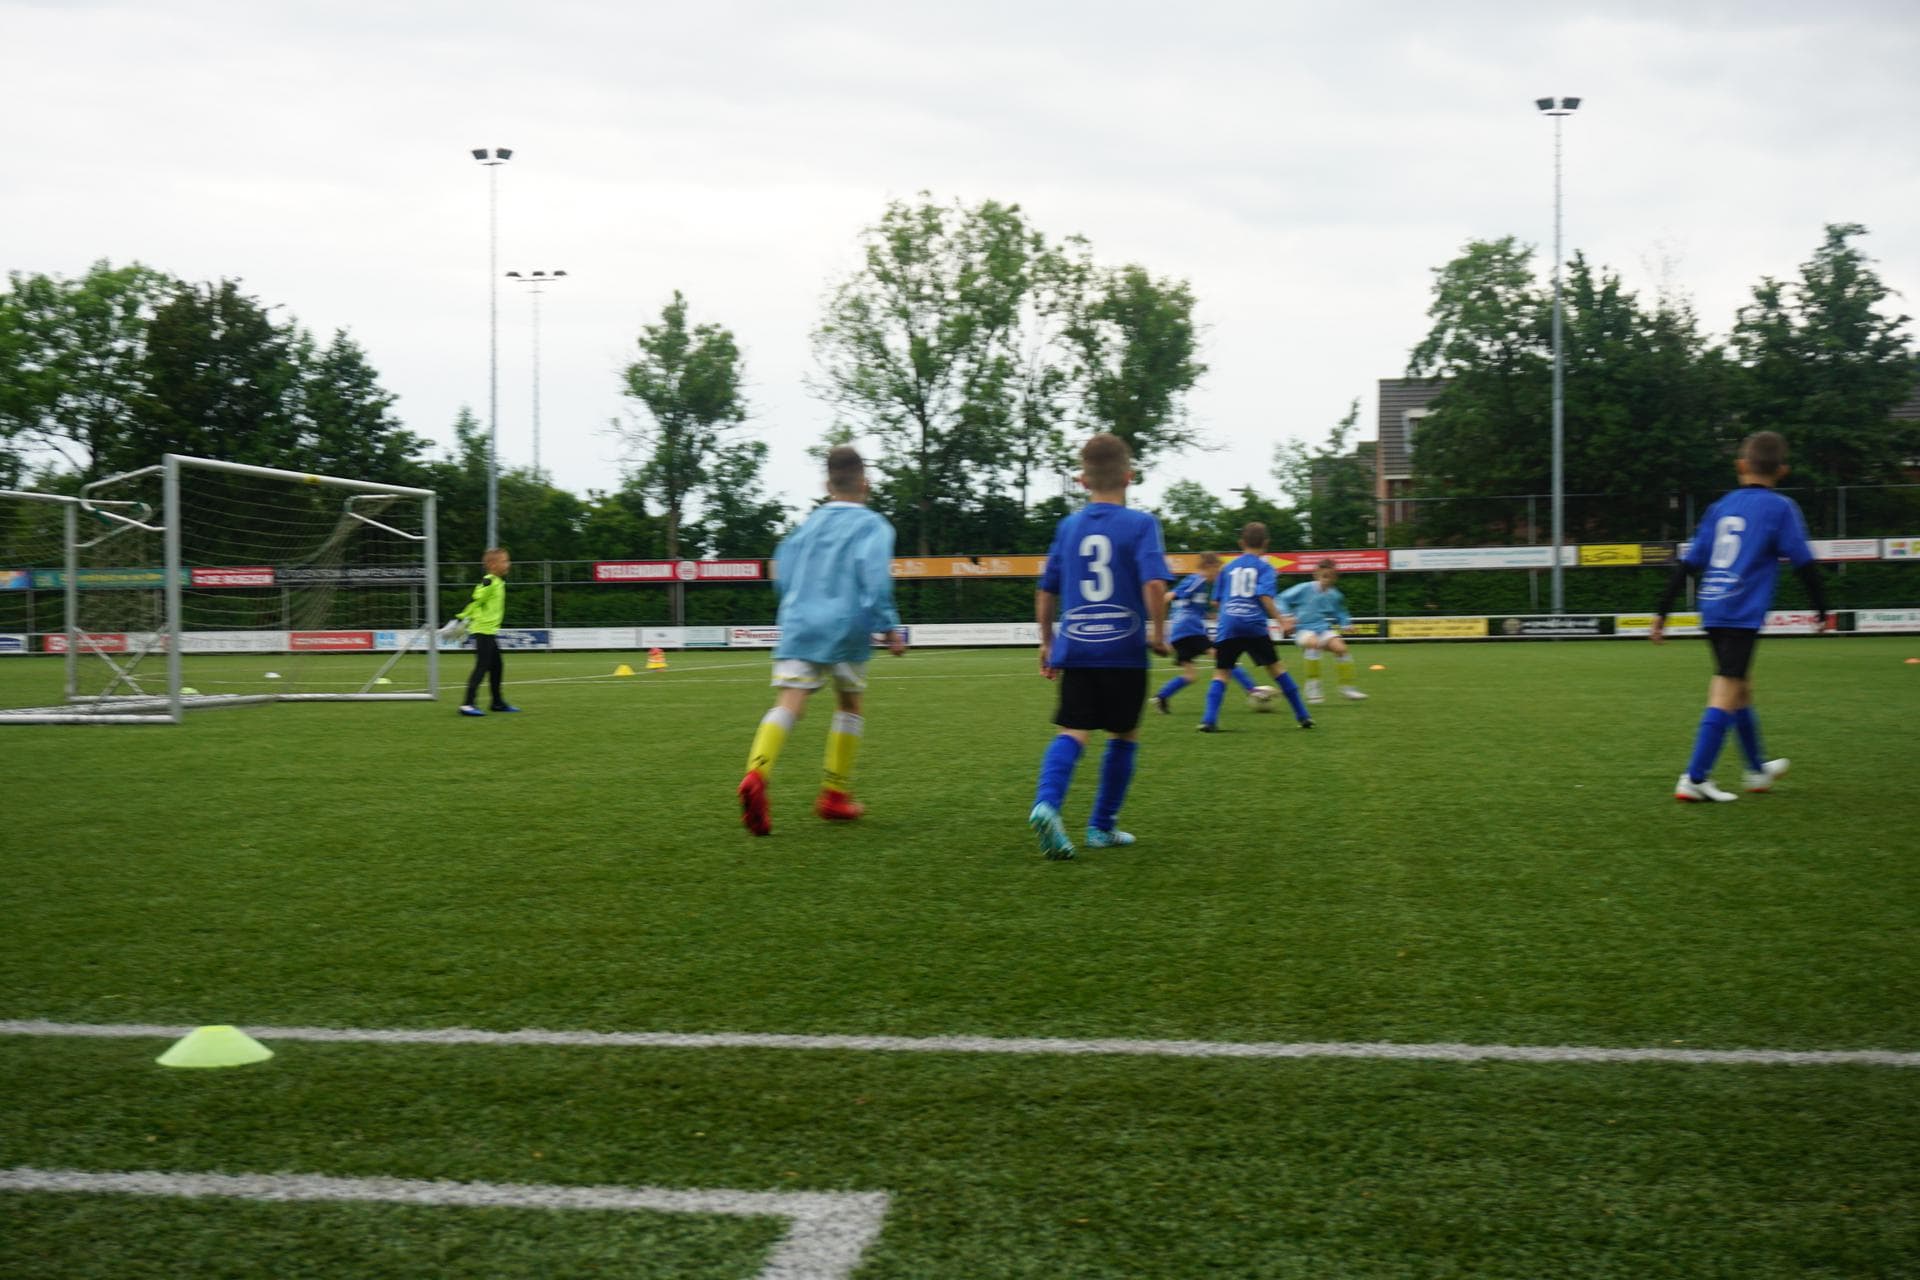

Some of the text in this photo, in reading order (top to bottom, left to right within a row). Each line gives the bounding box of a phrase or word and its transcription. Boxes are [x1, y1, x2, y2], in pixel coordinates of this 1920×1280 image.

[1079, 534, 1114, 602] 3
[1710, 516, 1746, 568] 6
[1229, 567, 1258, 597] 10
